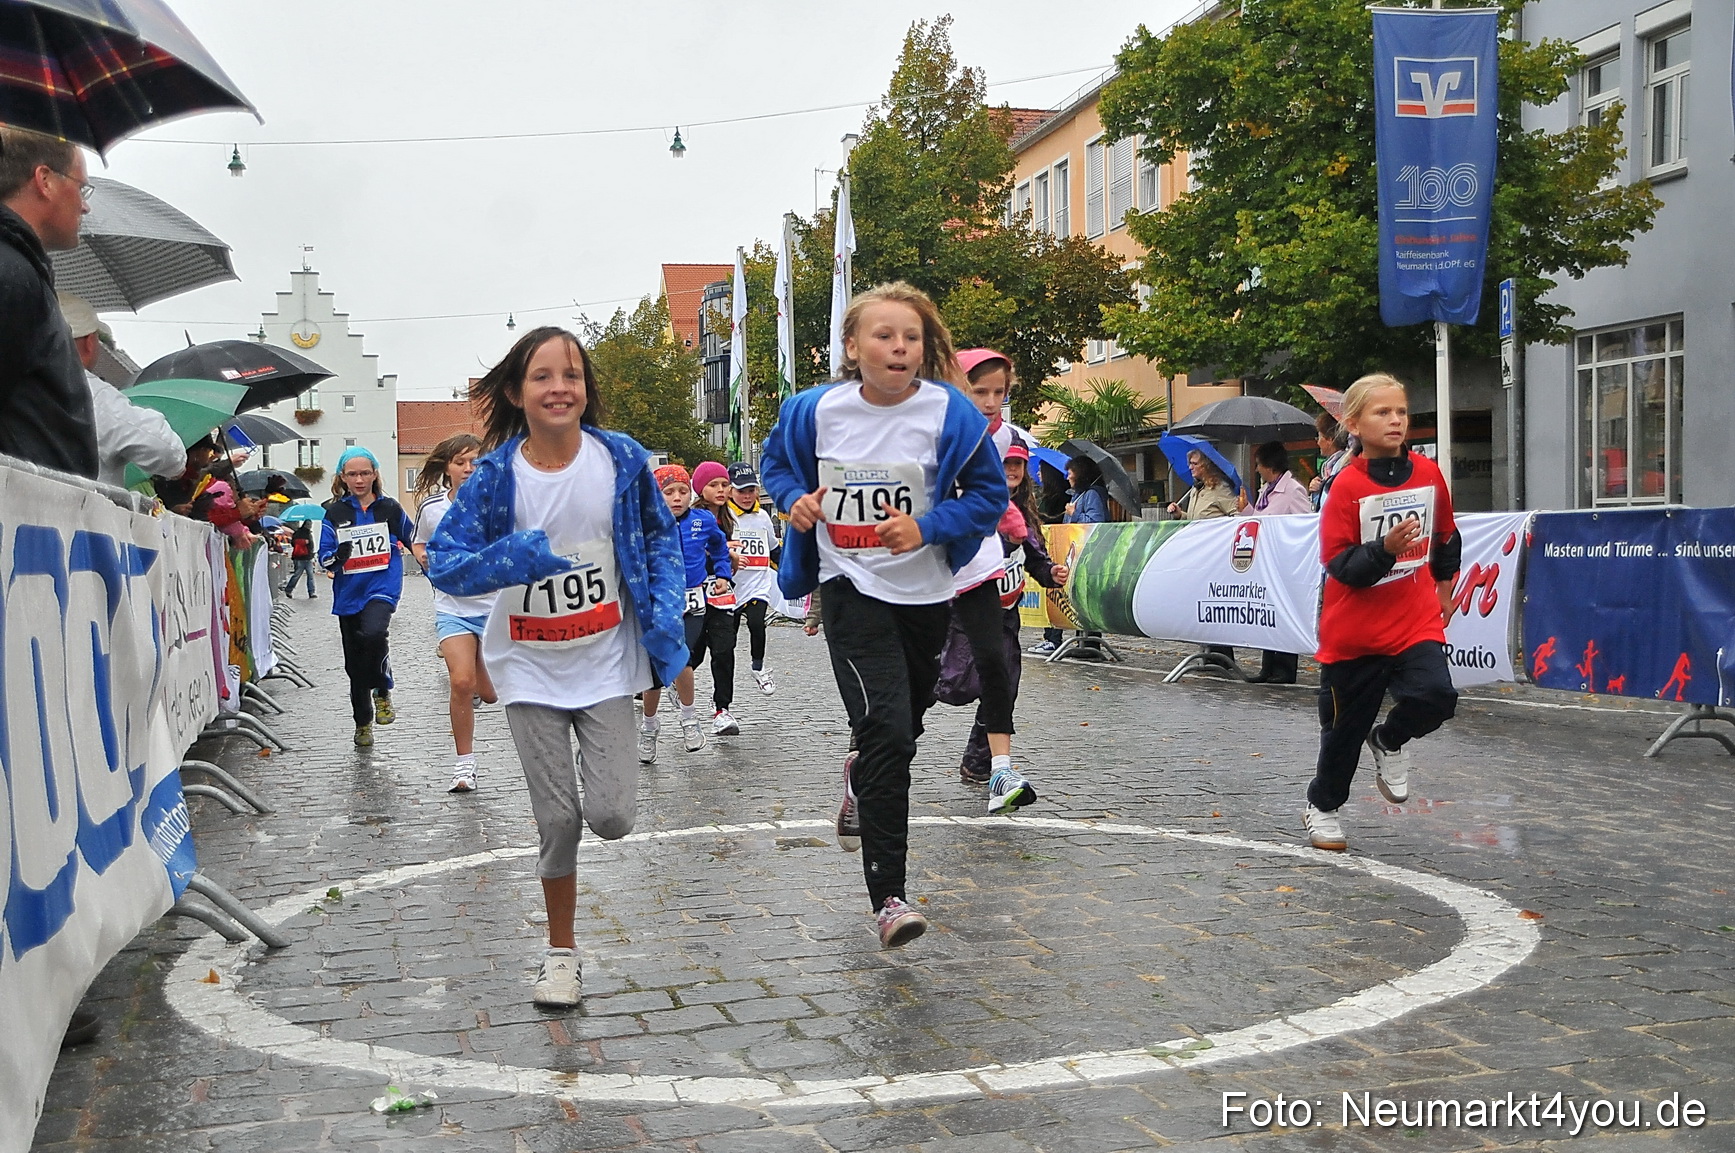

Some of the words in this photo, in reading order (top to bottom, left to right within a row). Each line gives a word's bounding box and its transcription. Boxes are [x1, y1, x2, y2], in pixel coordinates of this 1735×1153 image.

[1395, 163, 1477, 213] 100
[1395, 249, 1450, 260] Raiffeisenbank
[1396, 261, 1432, 270] Neumarkt
[1463, 259, 1475, 268] eG
[1501, 287, 1509, 331] P
[845, 470, 889, 480] BOCK
[832, 486, 912, 522] 7196
[1383, 494, 1416, 507] BOCK
[355, 535, 386, 556] 142
[740, 539, 765, 555] 266
[1544, 542, 1584, 558] Masten
[1587, 541, 1611, 558] und
[1614, 541, 1653, 558] Türme
[1674, 541, 1701, 558] sind
[522, 567, 607, 614] 7195
[1208, 581, 1266, 600] Neumarkter
[1197, 601, 1276, 628] Lammsbräu
[1443, 644, 1496, 669] Radio
